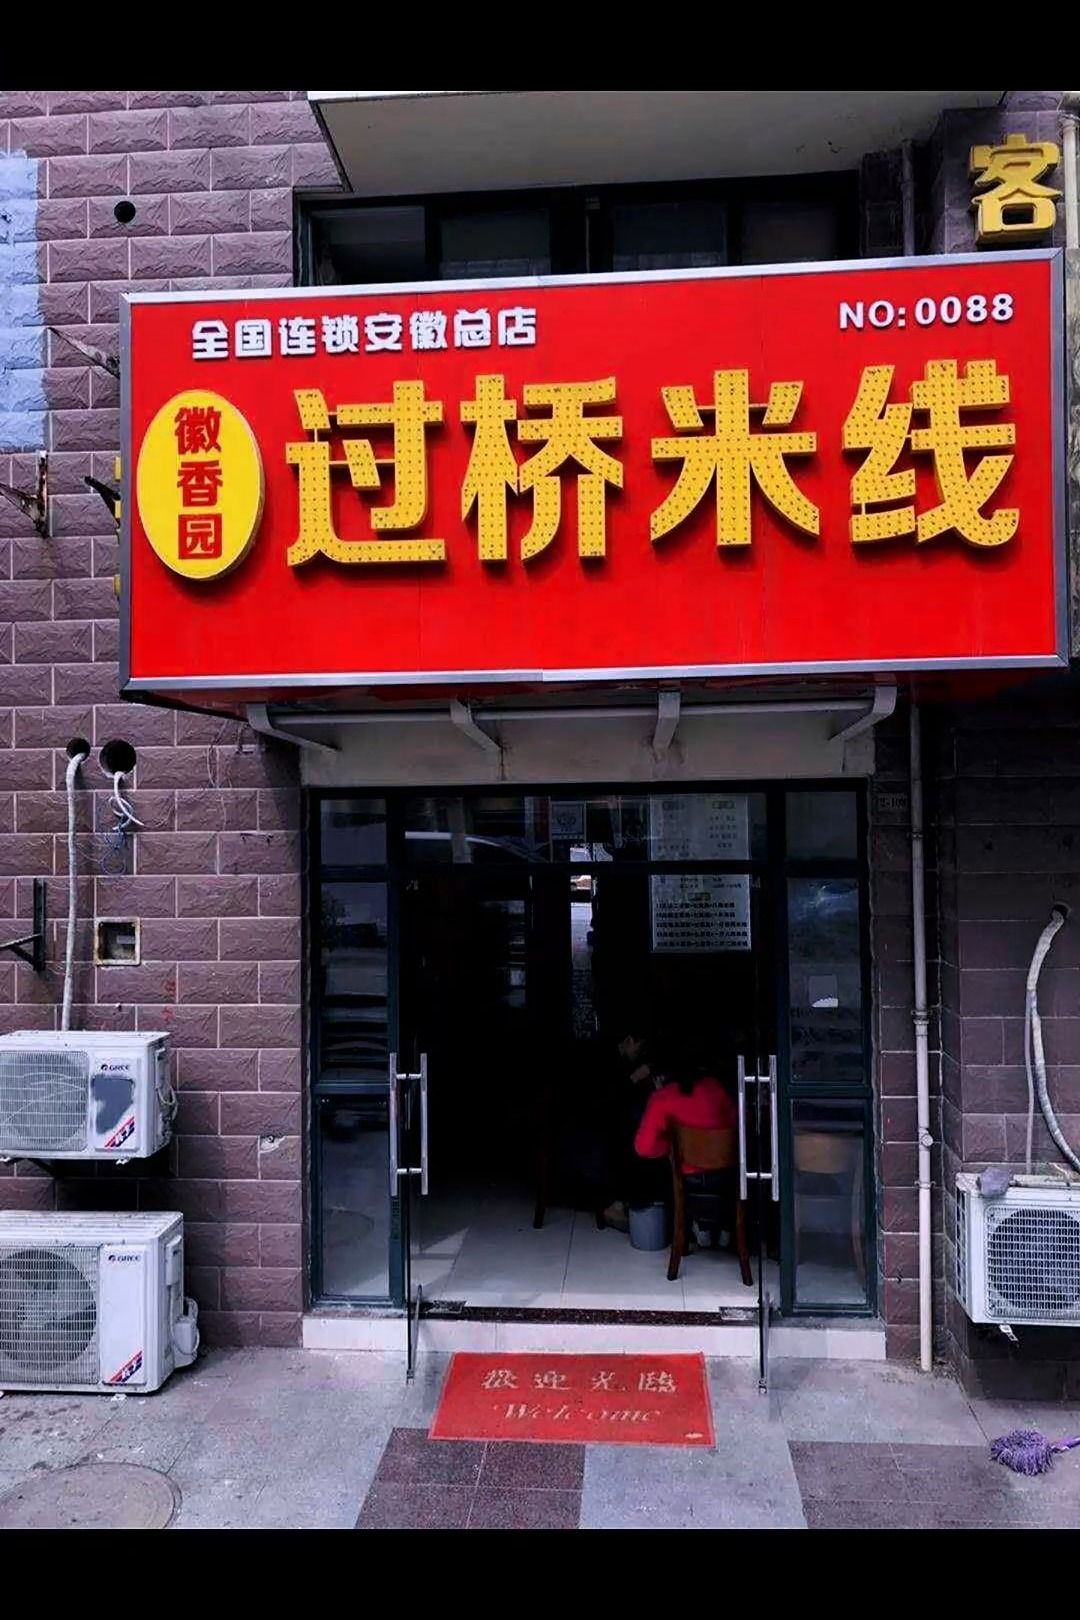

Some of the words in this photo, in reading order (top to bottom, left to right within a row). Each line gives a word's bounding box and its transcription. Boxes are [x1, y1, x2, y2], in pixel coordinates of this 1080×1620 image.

[969, 133, 1062, 243] 客
[192, 307, 536, 359] 全国连锁安徽总店
[174, 406, 223, 560] 徽香园
[286, 359, 1020, 568] 过桥米线
